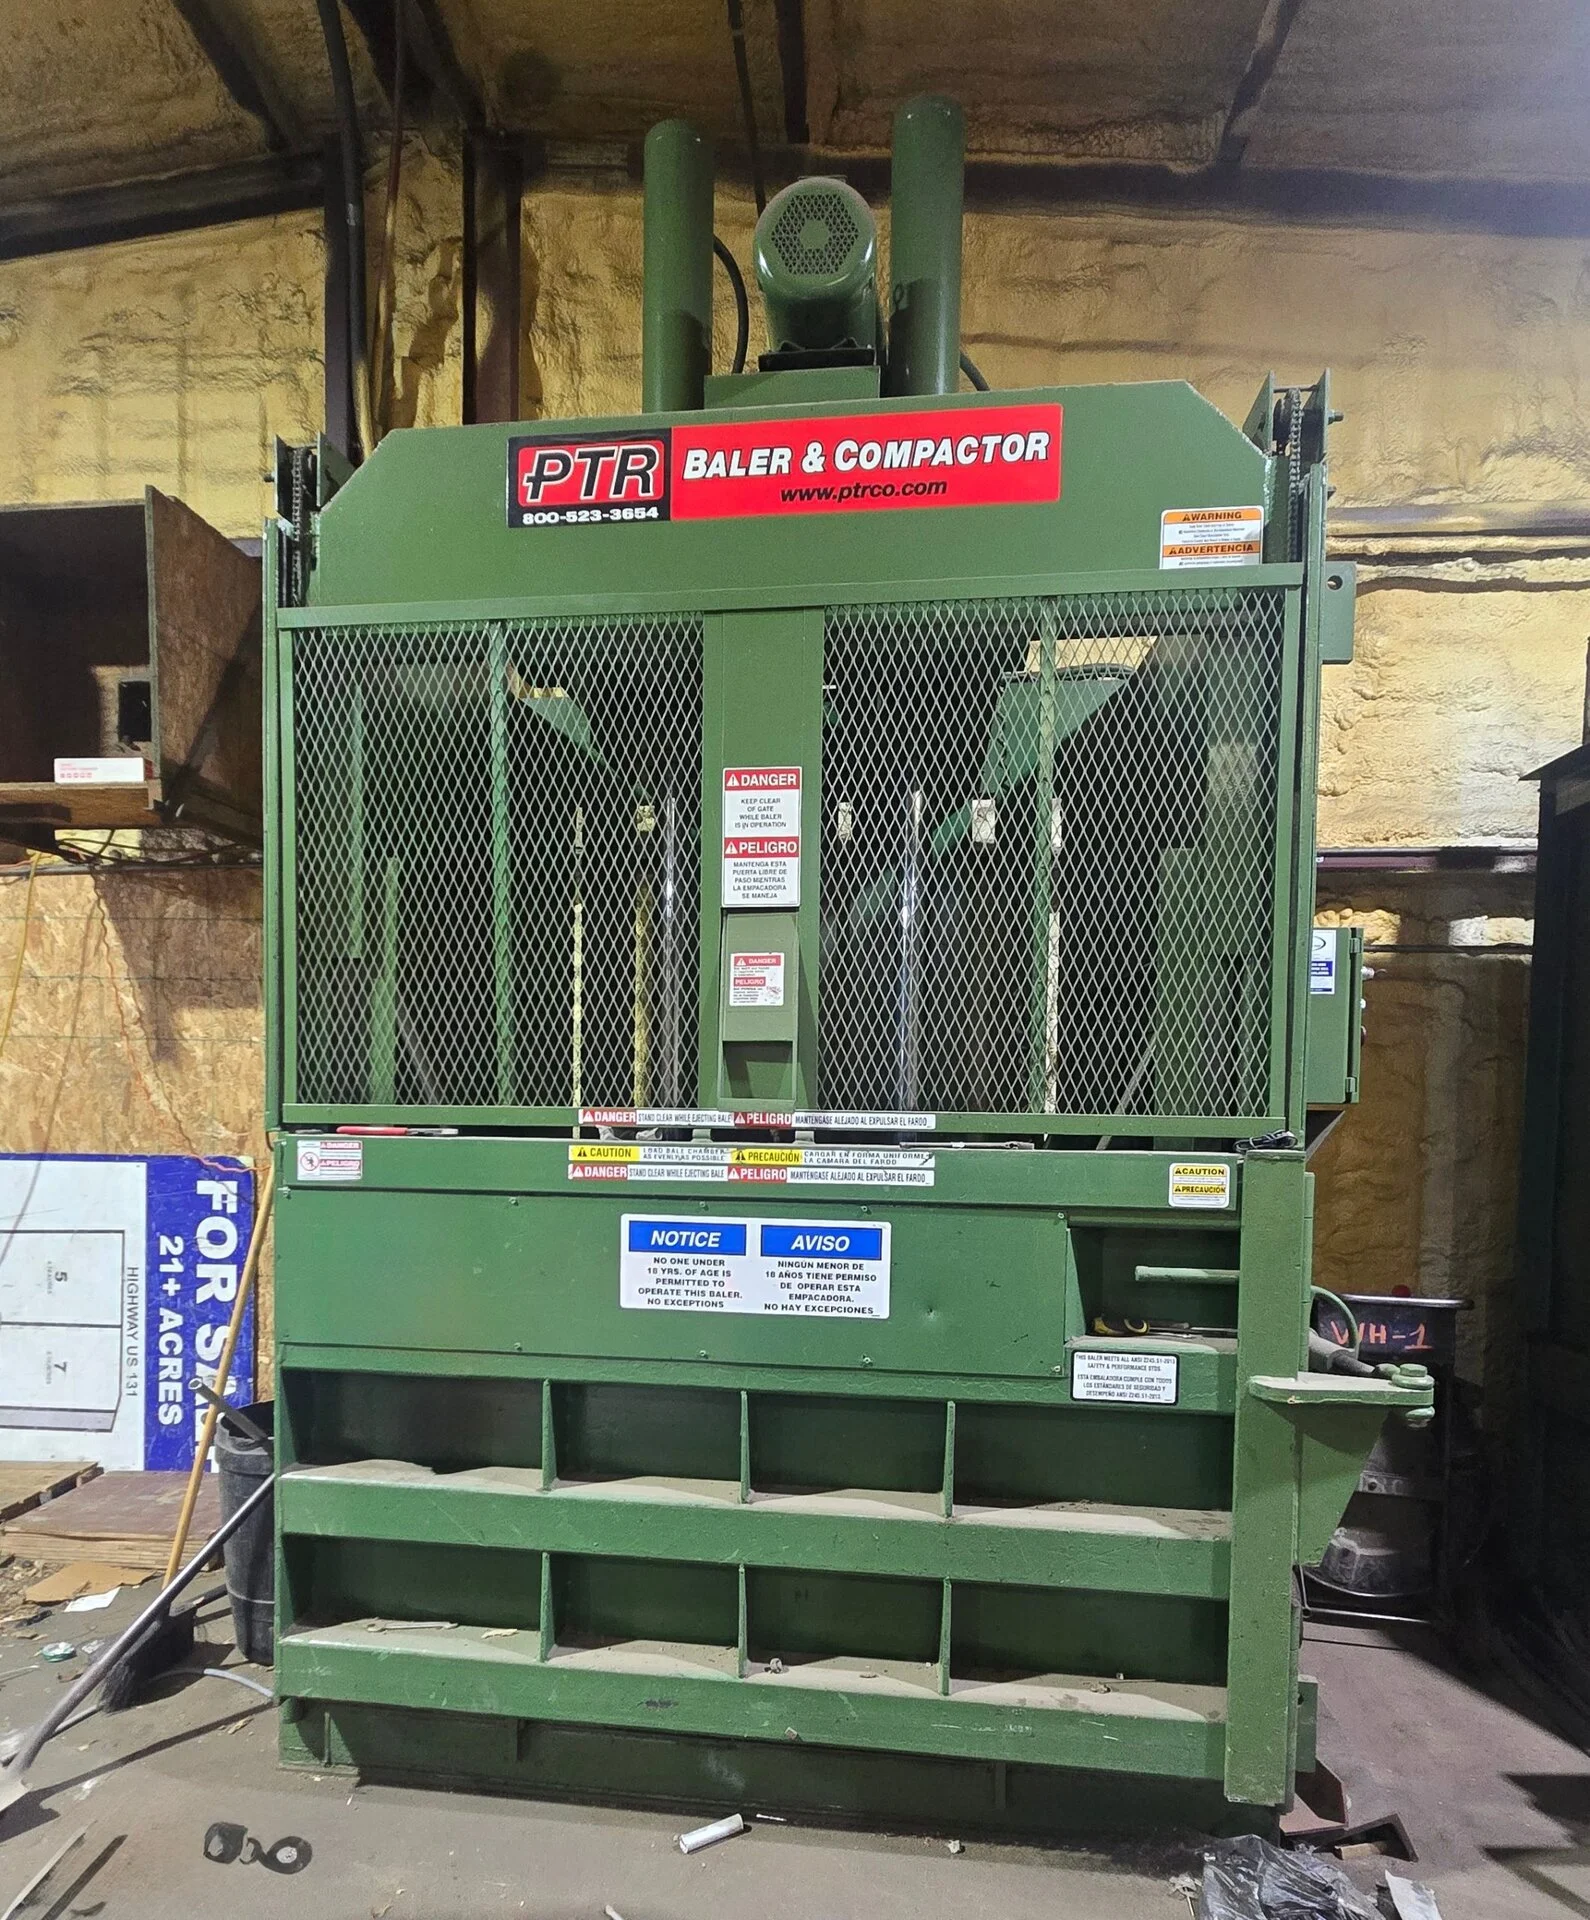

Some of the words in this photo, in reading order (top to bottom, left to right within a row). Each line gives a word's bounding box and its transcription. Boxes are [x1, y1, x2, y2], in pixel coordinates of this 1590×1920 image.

[682, 445, 793, 480] BALER
[800, 442, 826, 472] &
[834, 431, 1050, 470] COMPACTOR
[524, 444, 661, 502] PTR
[779, 478, 948, 503] www.ptrco.com
[522, 505, 660, 525] 800-523-3654
[1191, 511, 1242, 521] WARNING
[1178, 543, 1254, 555] ADVERTENCIA
[740, 773, 797, 787] DANGER
[739, 841, 798, 854] PELIGRO
[734, 978, 765, 986] PELIGRO
[594, 1111, 636, 1122] DANGER
[638, 1113, 655, 1122] STAND
[656, 1113, 673, 1122] CLEAR
[674, 1113, 691, 1122] WHILE
[692, 1113, 717, 1123] EJECTING
[718, 1114, 732, 1123] BALE
[747, 1112, 792, 1125] PELIGRO
[834, 1115, 860, 1125] ALEJADO
[861, 1116, 868, 1125] AL
[869, 1116, 899, 1126] EXPULSAR
[900, 1117, 906, 1126] EL
[907, 1117, 928, 1127] FARDO
[589, 1147, 632, 1158] CAUTION
[691, 1154, 725, 1162] POSSIBLE
[748, 1150, 800, 1163] PRECAUCIÓN
[584, 1166, 627, 1178] DANGER
[629, 1168, 646, 1177] STAND
[647, 1168, 665, 1177] CLEAR
[666, 1169, 683, 1177] WHILE
[684, 1169, 710, 1178] EJECTING
[710, 1169, 725, 1178] BALE
[740, 1168, 787, 1180] PELIGRO
[830, 1171, 856, 1181] ALEJADO
[857, 1172, 865, 1181] AL
[866, 1172, 896, 1182] EXPULSAR
[897, 1173, 904, 1182] EL
[905, 1173, 926, 1183] FARDO
[195, 1180, 239, 1305] FOR
[650, 1229, 722, 1249] NOTICE
[791, 1235, 851, 1252] AVISO
[159, 1234, 185, 1297] 21+
[653, 1257, 667, 1265] NO
[669, 1257, 690, 1266] ONE
[692, 1258, 726, 1267] UNDER
[777, 1260, 814, 1269] NINGÚN
[816, 1261, 850, 1270] MENOR
[852, 1263, 865, 1271] DE
[55, 1270, 68, 1283] 5
[647, 1267, 658, 1275] 18
[660, 1267, 682, 1276] YRS.
[684, 1268, 698, 1276] OF
[700, 1269, 720, 1277] AGE
[722, 1269, 732, 1278] IS
[765, 1270, 776, 1278] 18
[778, 1269, 804, 1279] AÑOS
[806, 1272, 834, 1280] TIENE
[835, 1273, 877, 1282] PERMISO
[655, 1278, 710, 1287] PERMITTED
[712, 1280, 726, 1288] TO
[779, 1282, 792, 1290] DE
[797, 1282, 835, 1291] OPERAR
[837, 1284, 861, 1292] ESTA
[637, 1287, 682, 1296] OPERATE
[684, 1289, 706, 1297] THIS
[708, 1290, 743, 1299] BALER.
[788, 1293, 855, 1303] EMPACADORA.
[126, 1266, 140, 1341] HIGHWAY
[663, 1298, 724, 1308] EXCEPTIONS
[764, 1303, 779, 1311] NO
[781, 1304, 801, 1312] HAY
[804, 1304, 874, 1314] EXCEPCIONES
[126, 1345, 139, 1367] US
[53, 1361, 67, 1374] 7
[158, 1307, 184, 1425] ACRES
[1111, 1363, 1147, 1371] PERFORMANCE
[126, 1372, 138, 1397] 131
